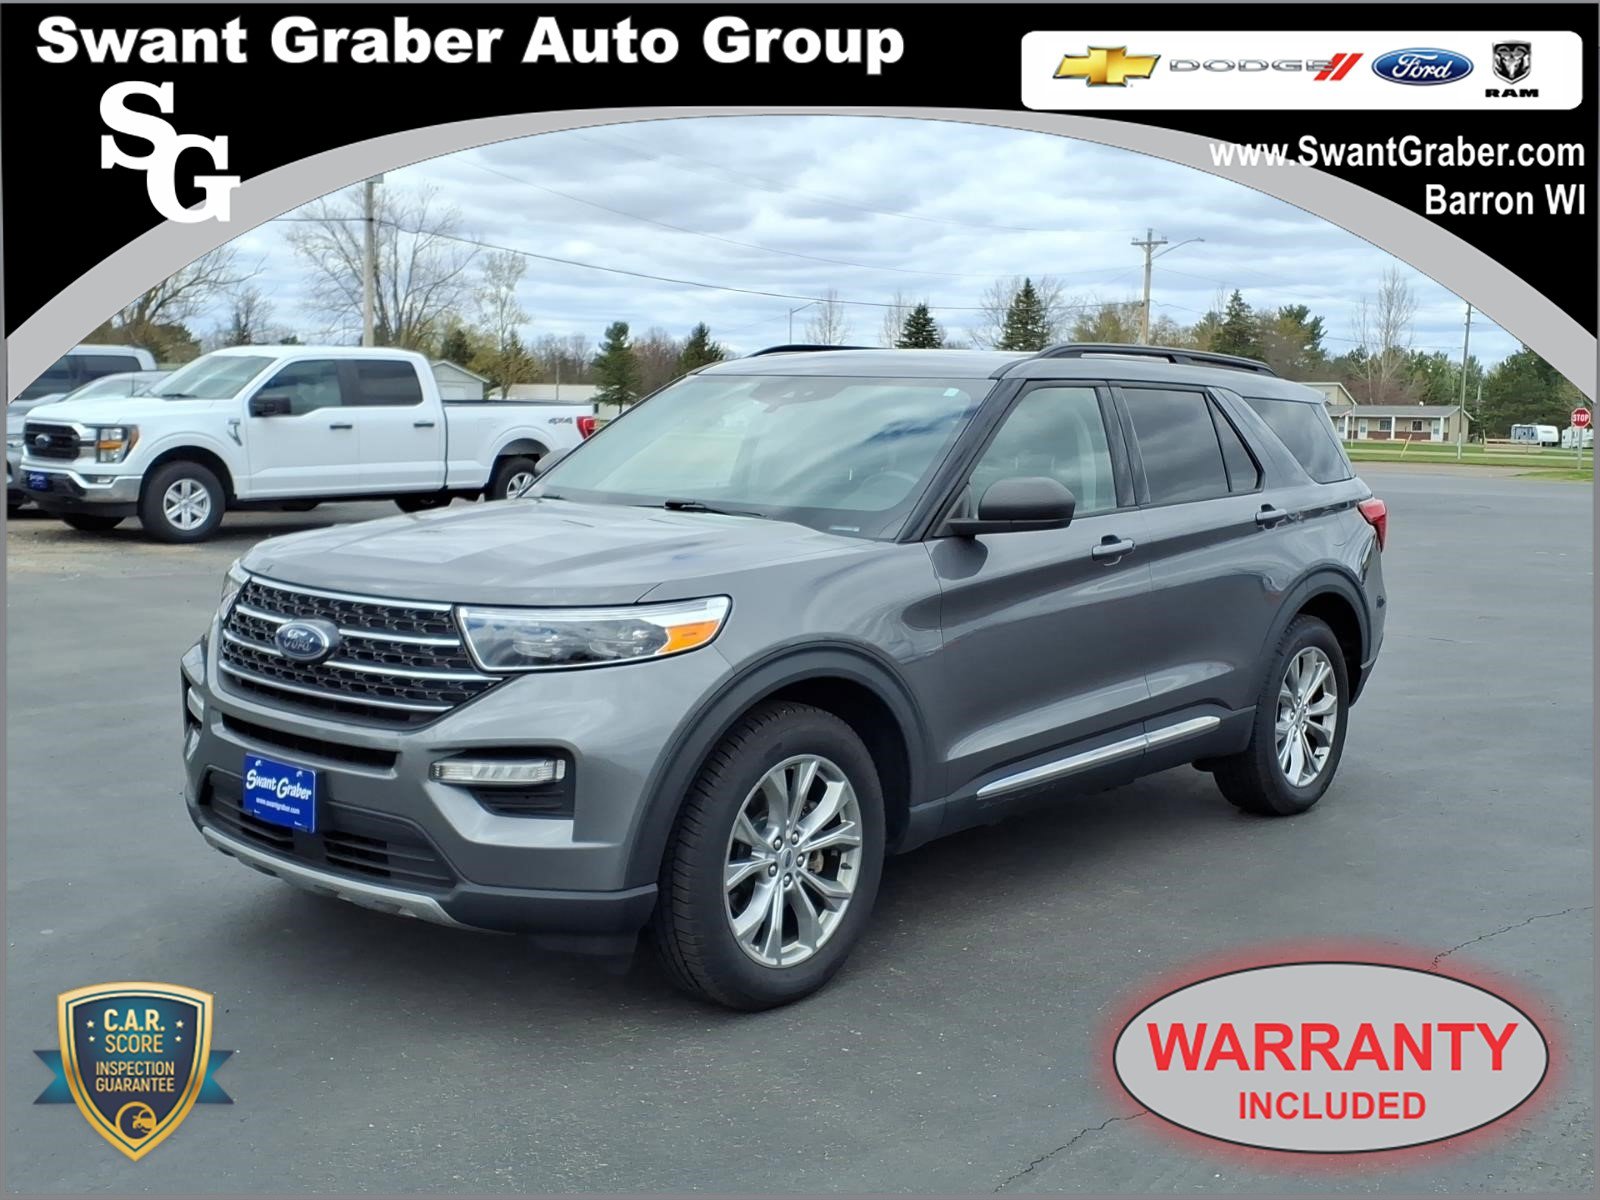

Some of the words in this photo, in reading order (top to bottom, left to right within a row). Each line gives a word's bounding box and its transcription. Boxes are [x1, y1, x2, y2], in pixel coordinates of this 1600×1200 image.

[1573, 414, 1589, 422] STOP
[246, 769, 277, 791] Swant
[276, 777, 312, 801] Graber
